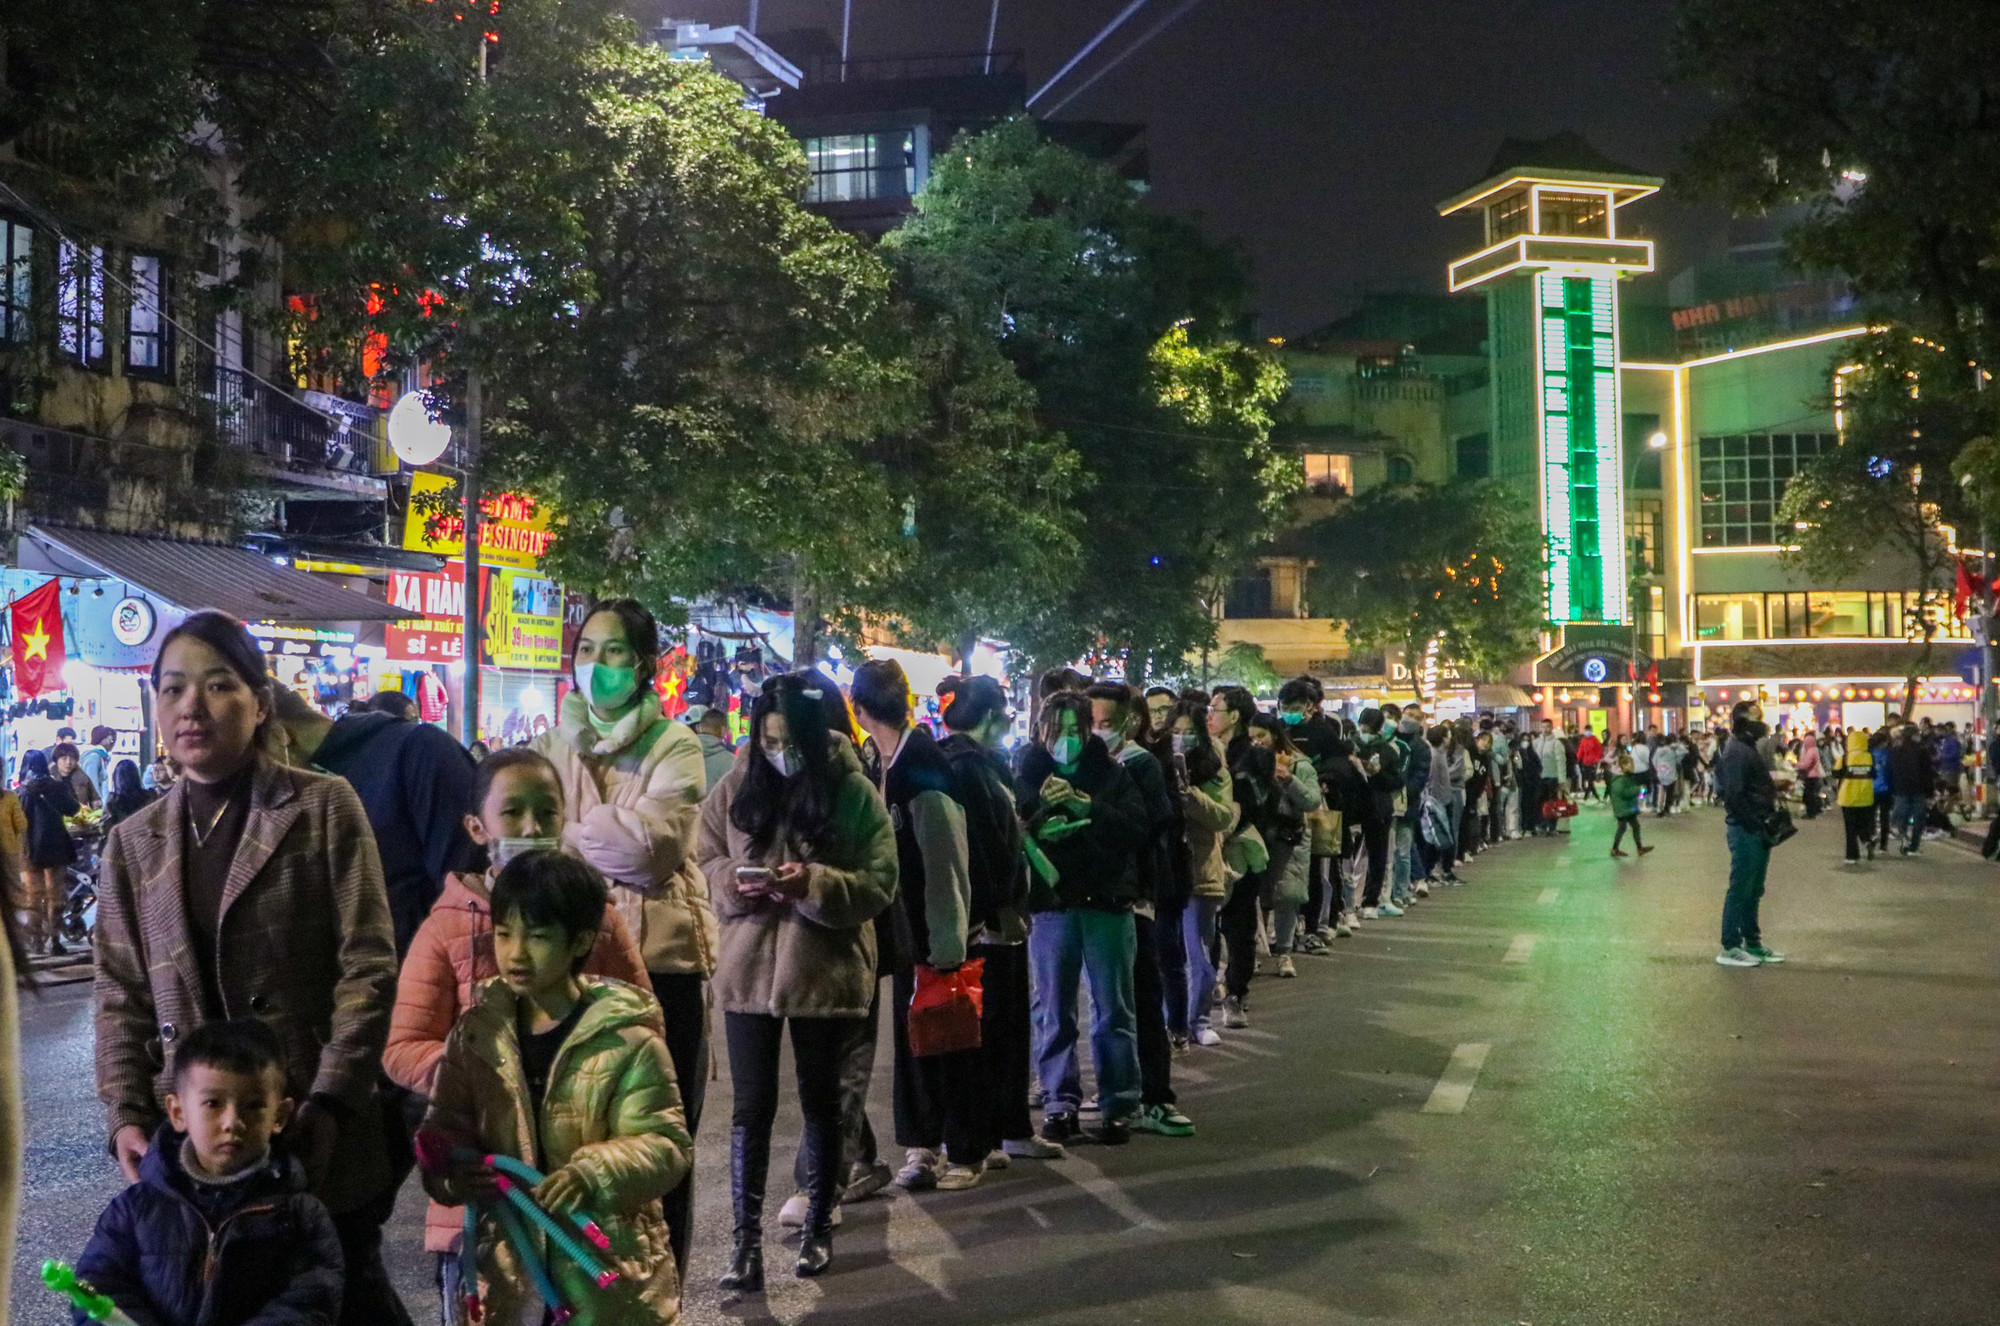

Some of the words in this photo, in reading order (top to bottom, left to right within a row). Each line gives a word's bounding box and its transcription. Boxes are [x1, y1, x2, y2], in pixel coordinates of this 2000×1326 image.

[494, 526, 549, 556] SINGIN
[426, 573, 464, 616] HÀN
[1392, 663, 1434, 680] DIN
